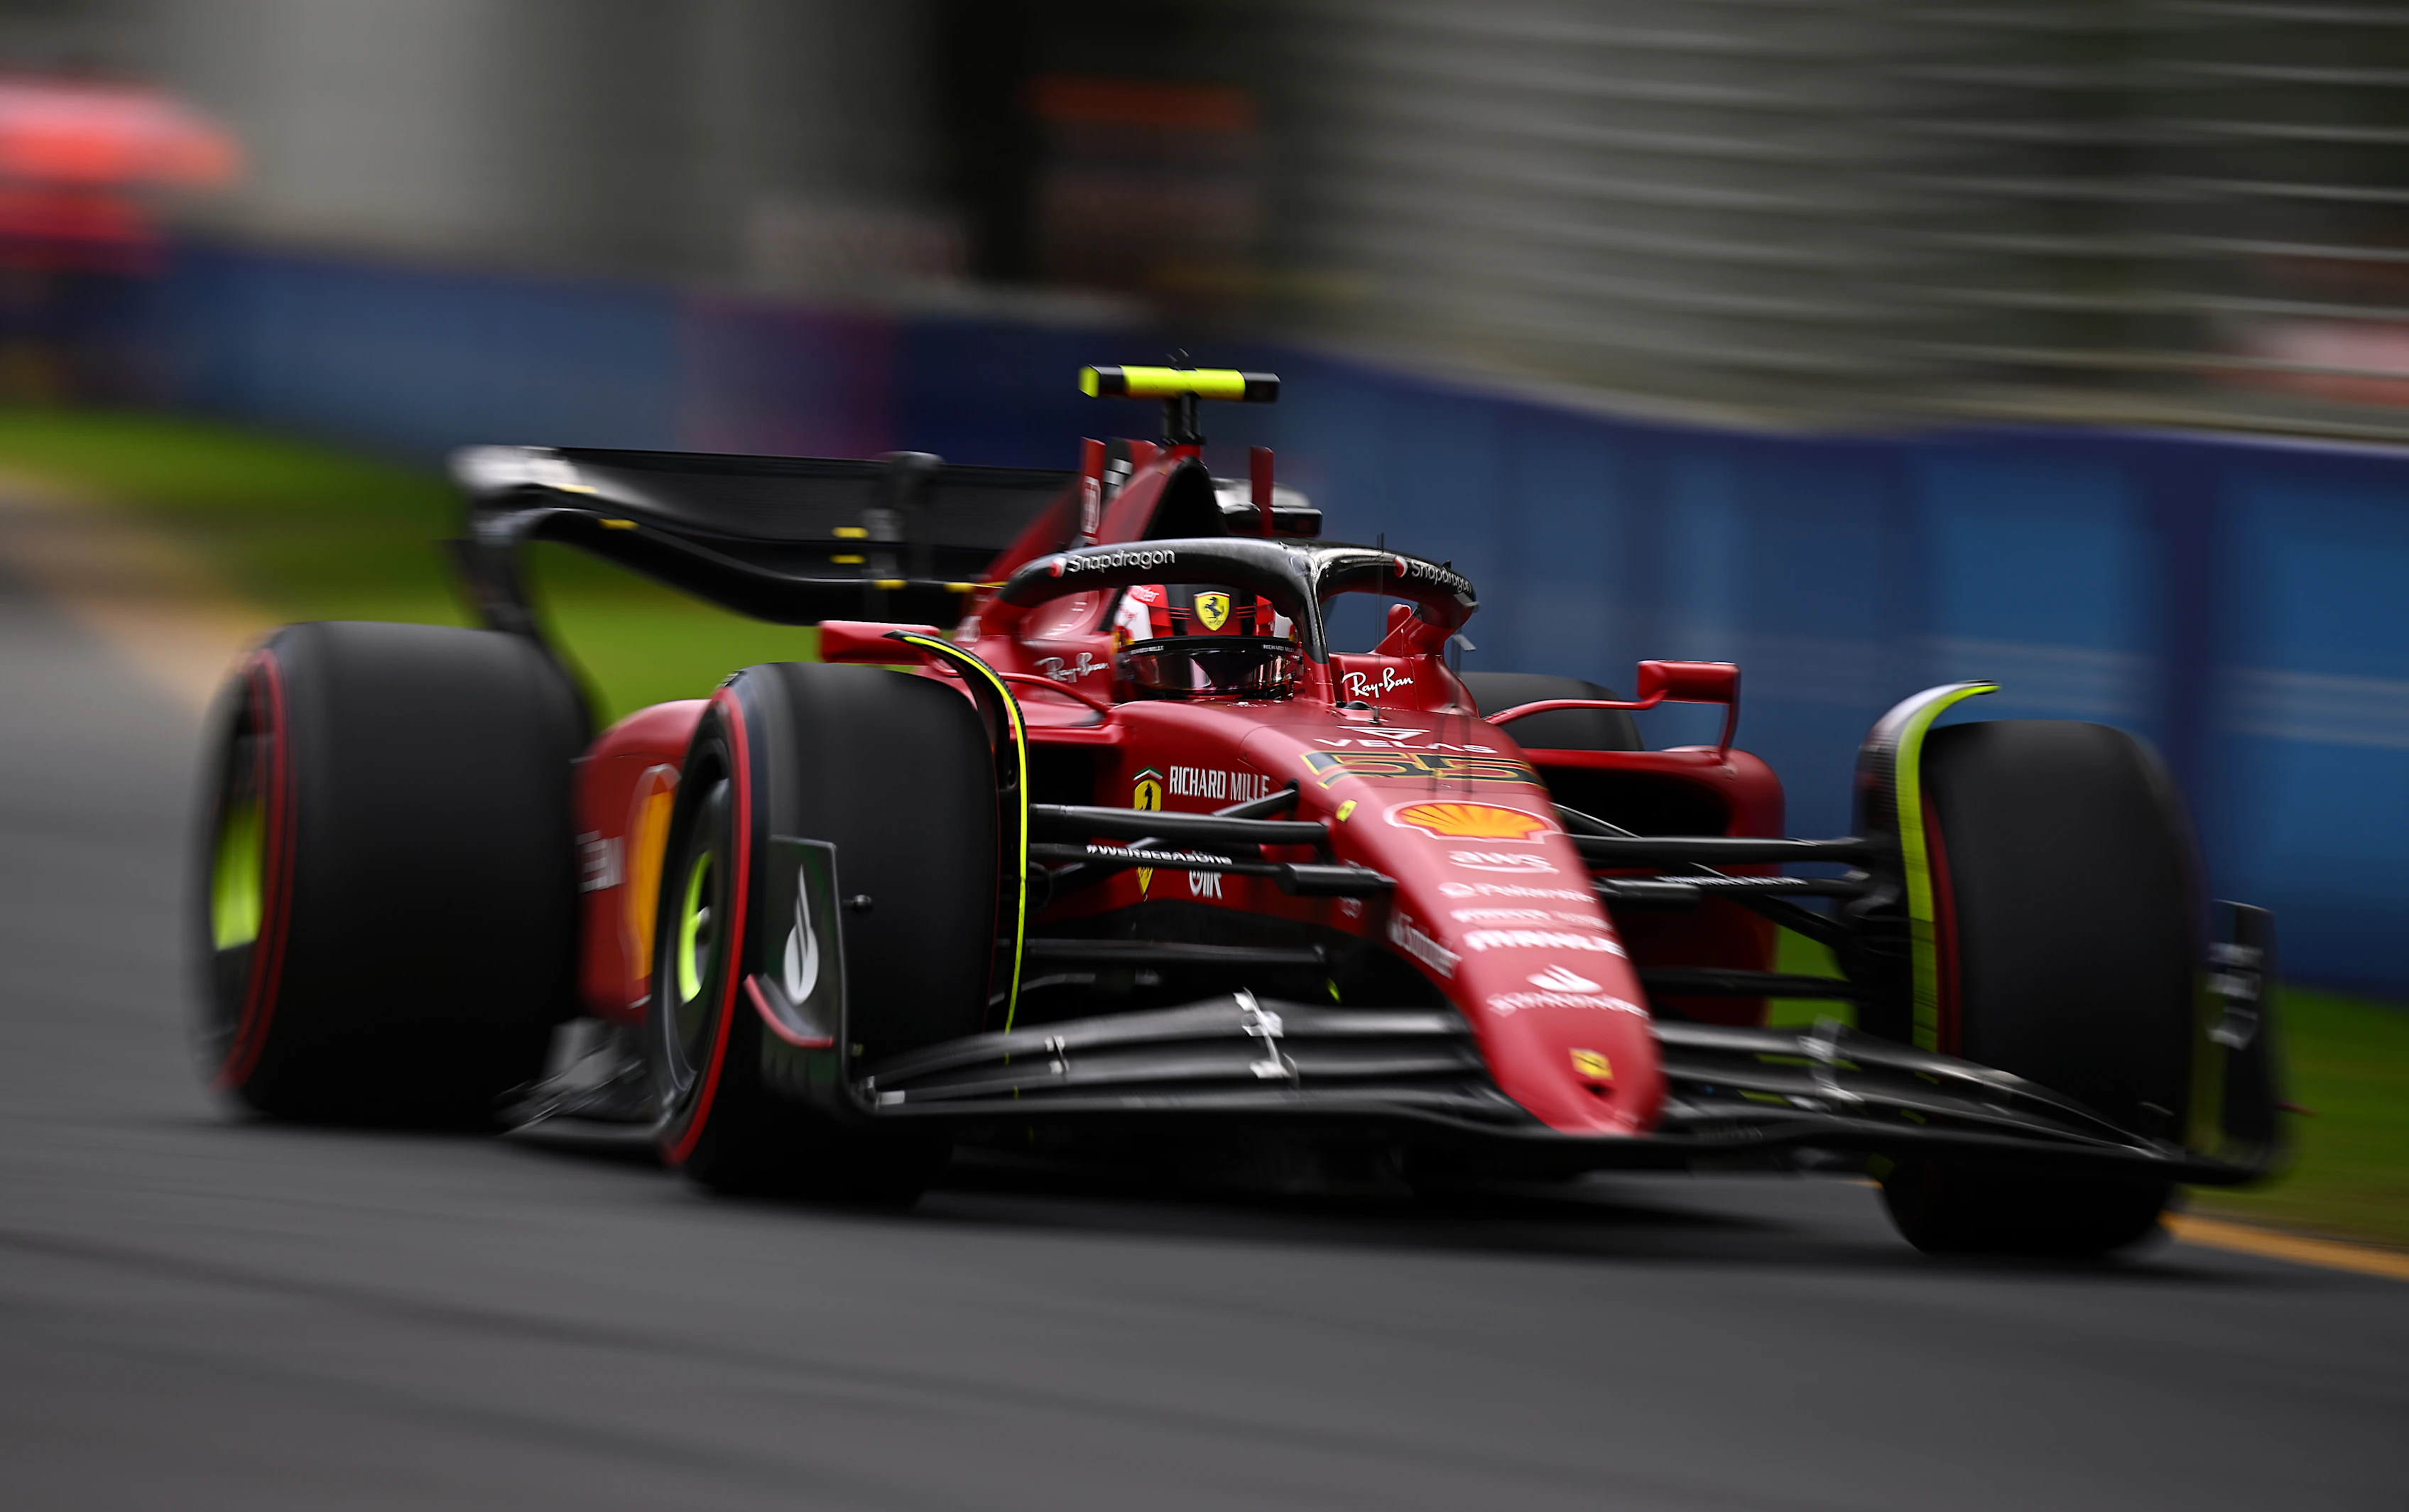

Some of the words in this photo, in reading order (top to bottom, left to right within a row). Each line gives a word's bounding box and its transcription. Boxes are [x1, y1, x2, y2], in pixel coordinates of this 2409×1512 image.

[1066, 548, 1175, 574] Snapdragon
[1410, 560, 1472, 593] Snapdragon
[1314, 738, 1498, 754] VELAS
[1169, 765, 1227, 800] RICHARD
[1230, 771, 1271, 802] MILLE
[1300, 750, 1550, 790] 55
[1086, 844, 1233, 865] #WeRaceAsOne
